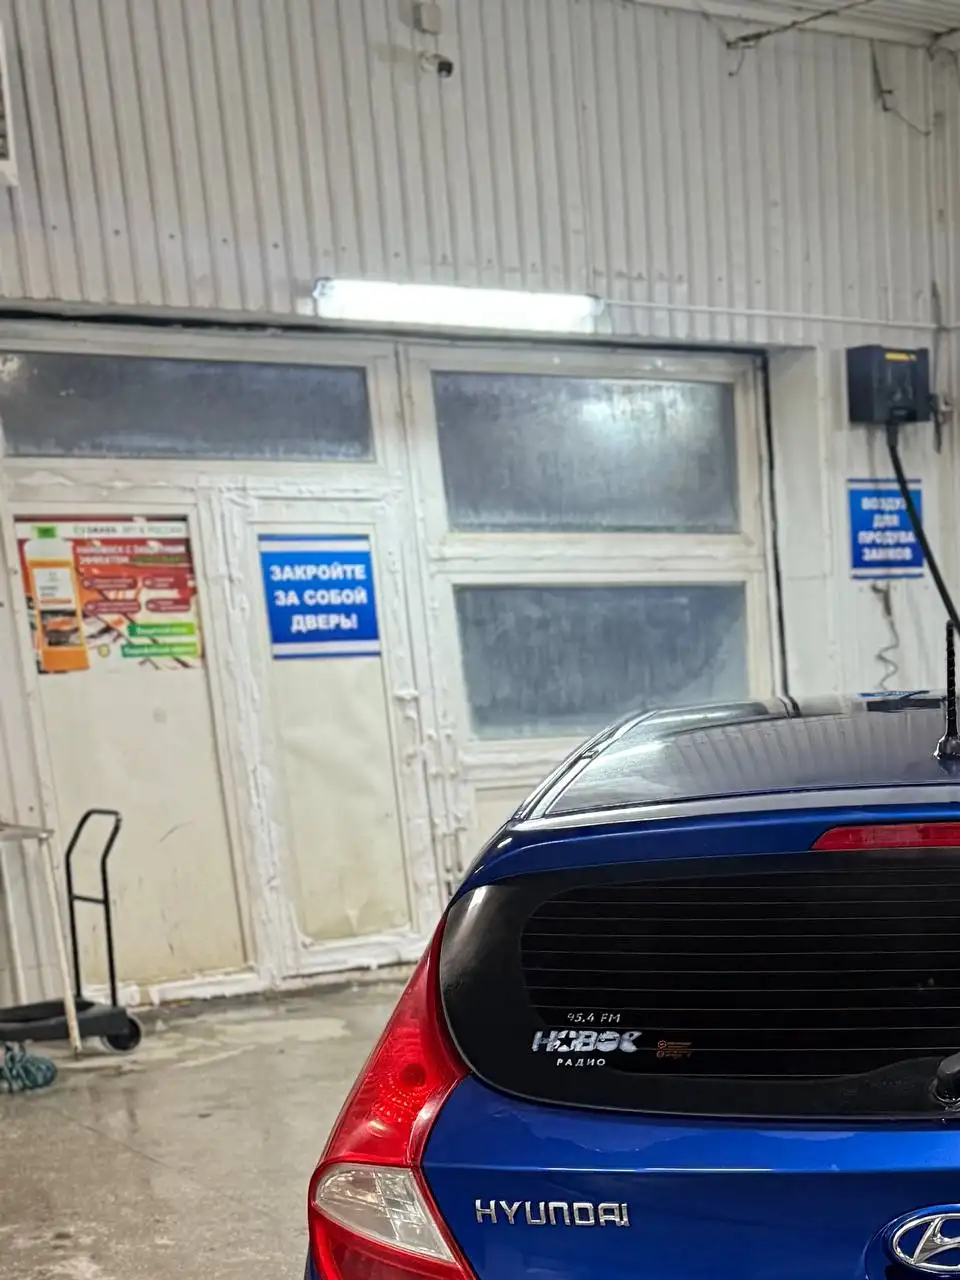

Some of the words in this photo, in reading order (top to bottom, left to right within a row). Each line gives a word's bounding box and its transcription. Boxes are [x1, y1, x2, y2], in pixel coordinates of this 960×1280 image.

[270, 561, 367, 581] ЗАКРОЙТЕ
[274, 589, 300, 606] ЗА
[303, 586, 368, 606] СОБОЙ
[567, 1013, 595, 1023] 95.4
[600, 1013, 621, 1023] FM
[557, 1058, 606, 1067] РАДИО
[475, 1199, 631, 1227] HYUNDAI
